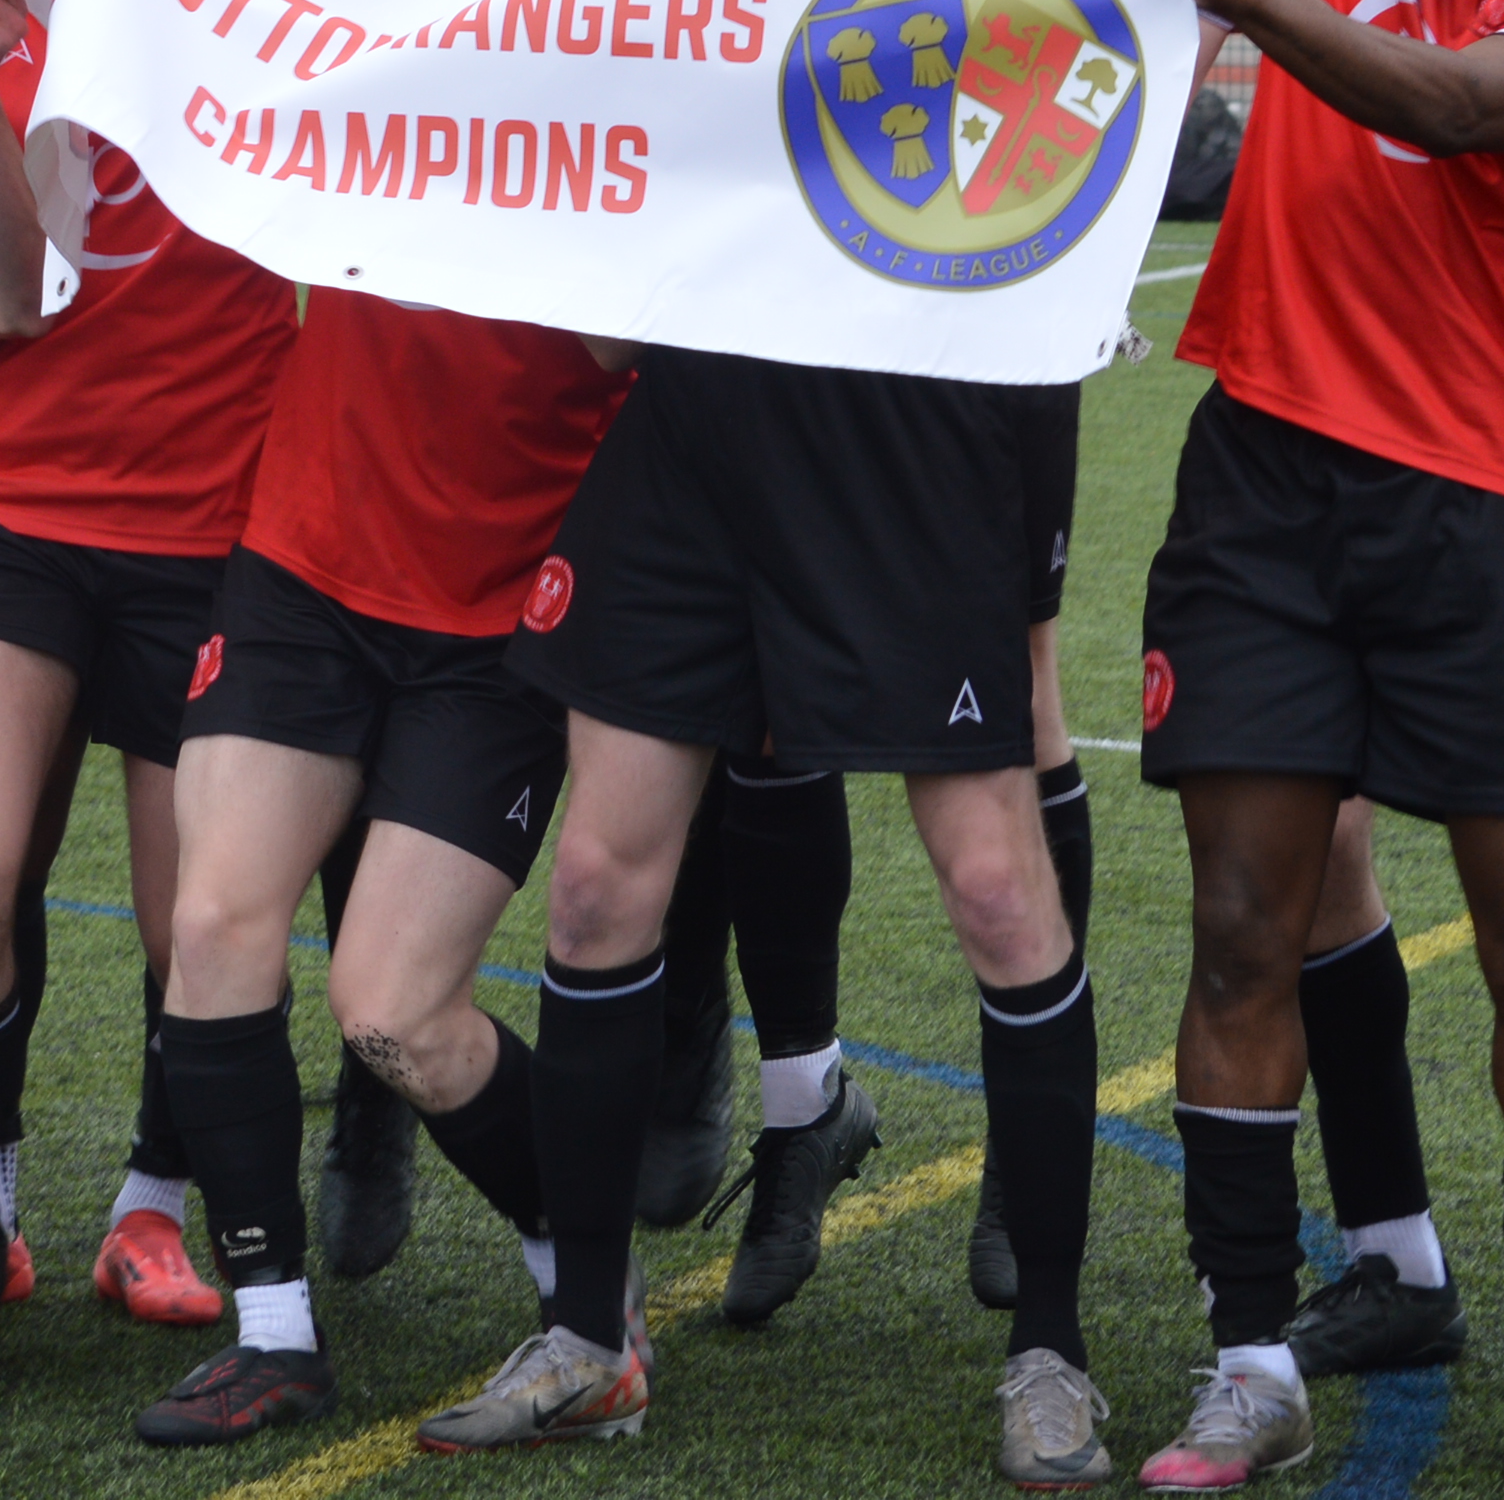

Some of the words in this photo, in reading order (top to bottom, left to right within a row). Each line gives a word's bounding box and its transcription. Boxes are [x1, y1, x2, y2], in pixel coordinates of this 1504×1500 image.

[183, 85, 649, 214] CHAMPIONS
[849, 230, 868, 253] A
[889, 250, 908, 270] F
[932, 237, 1050, 281] LEAGUE
